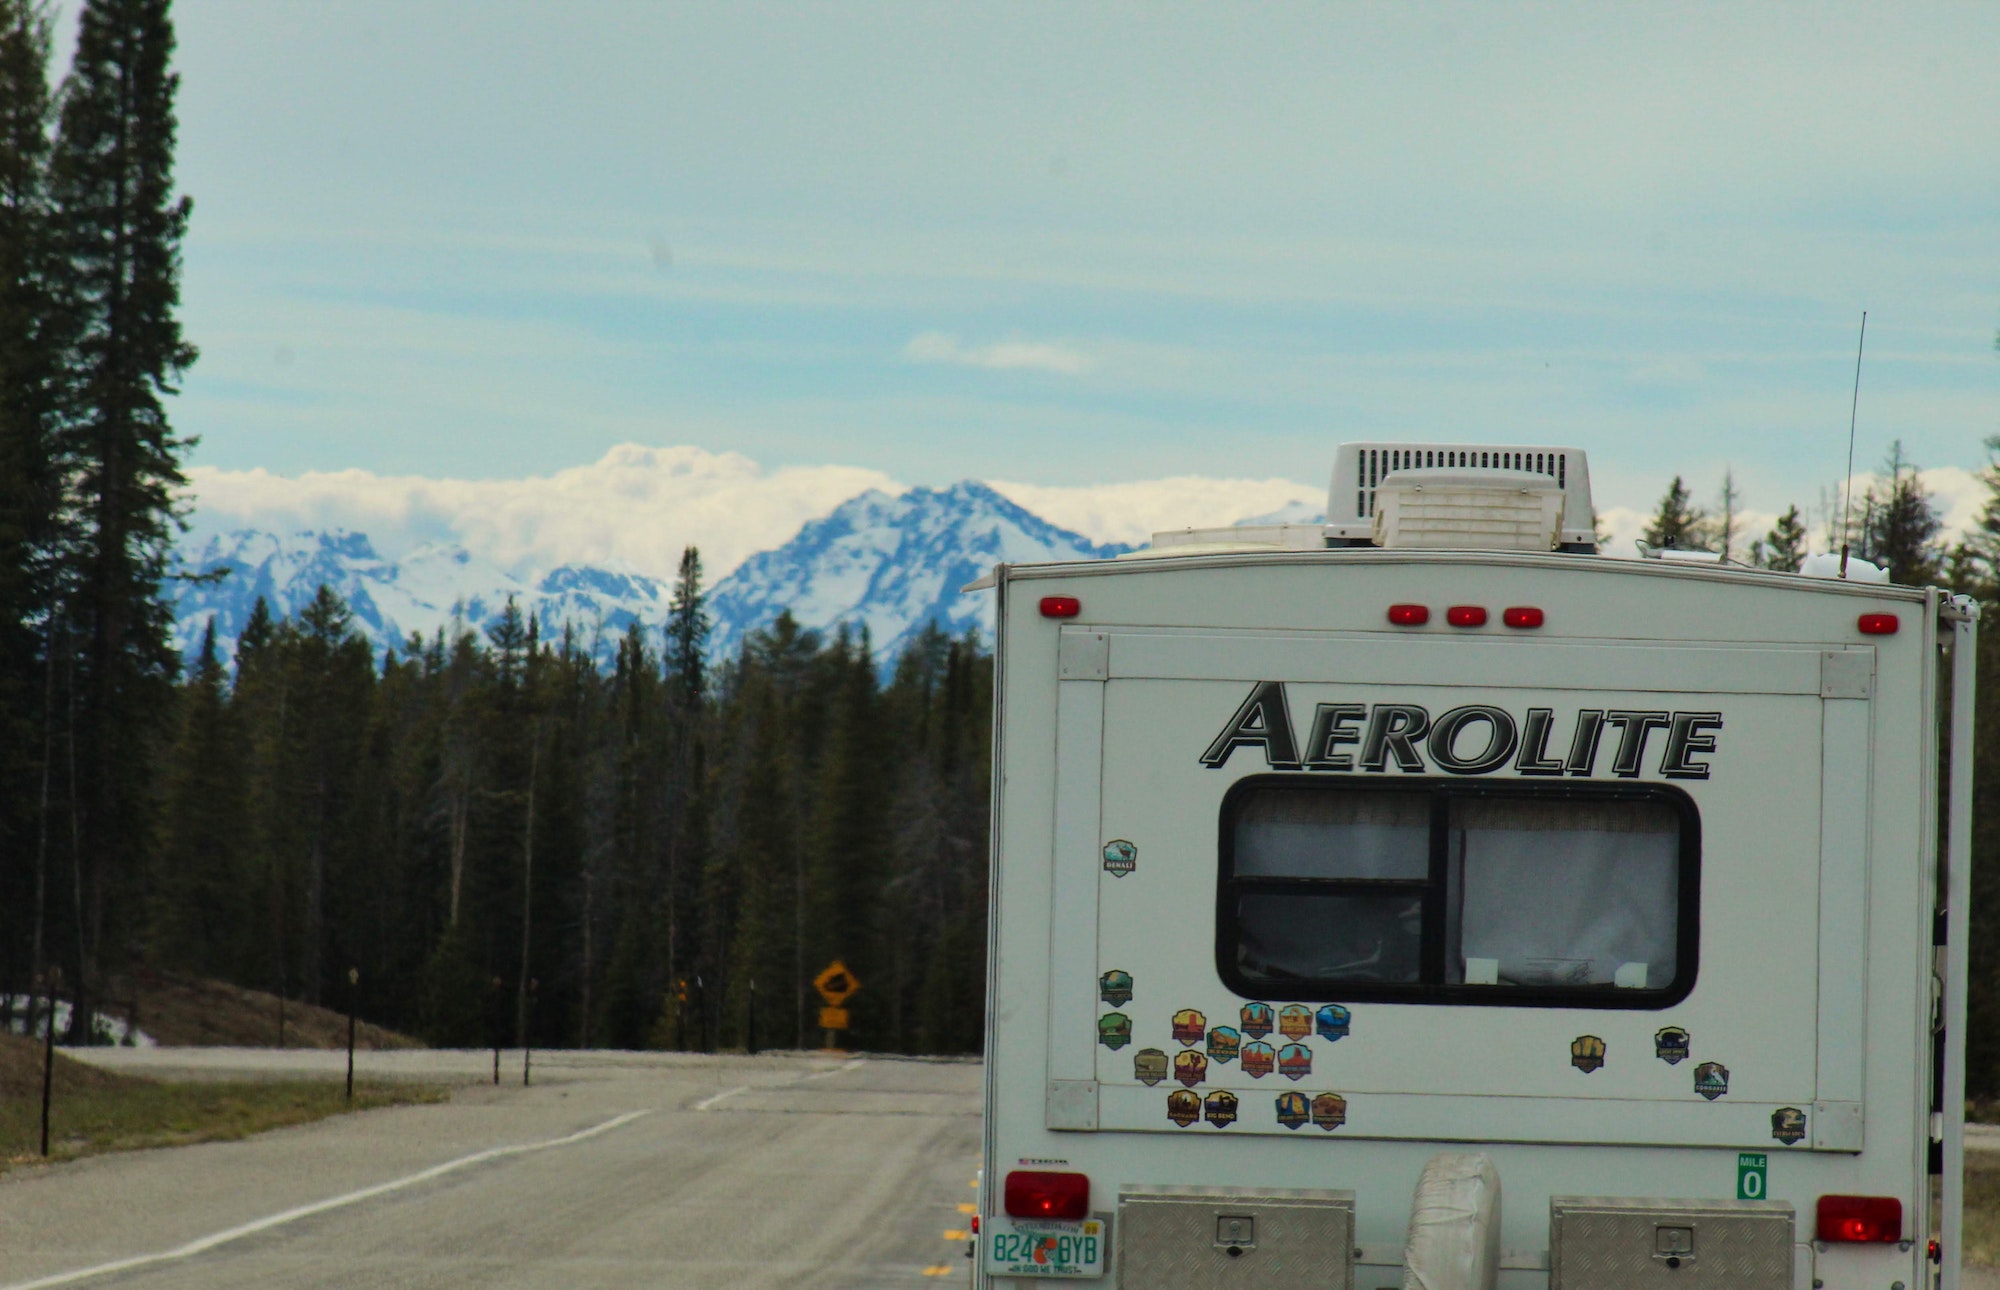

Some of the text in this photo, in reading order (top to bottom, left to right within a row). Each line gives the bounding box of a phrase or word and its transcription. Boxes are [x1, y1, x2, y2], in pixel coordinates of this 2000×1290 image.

[1200, 680, 1723, 779] AEROLITE
[1740, 1157, 1766, 1167] MILE
[1743, 1171, 1762, 1197] 0
[994, 1234, 1033, 1262] 824
